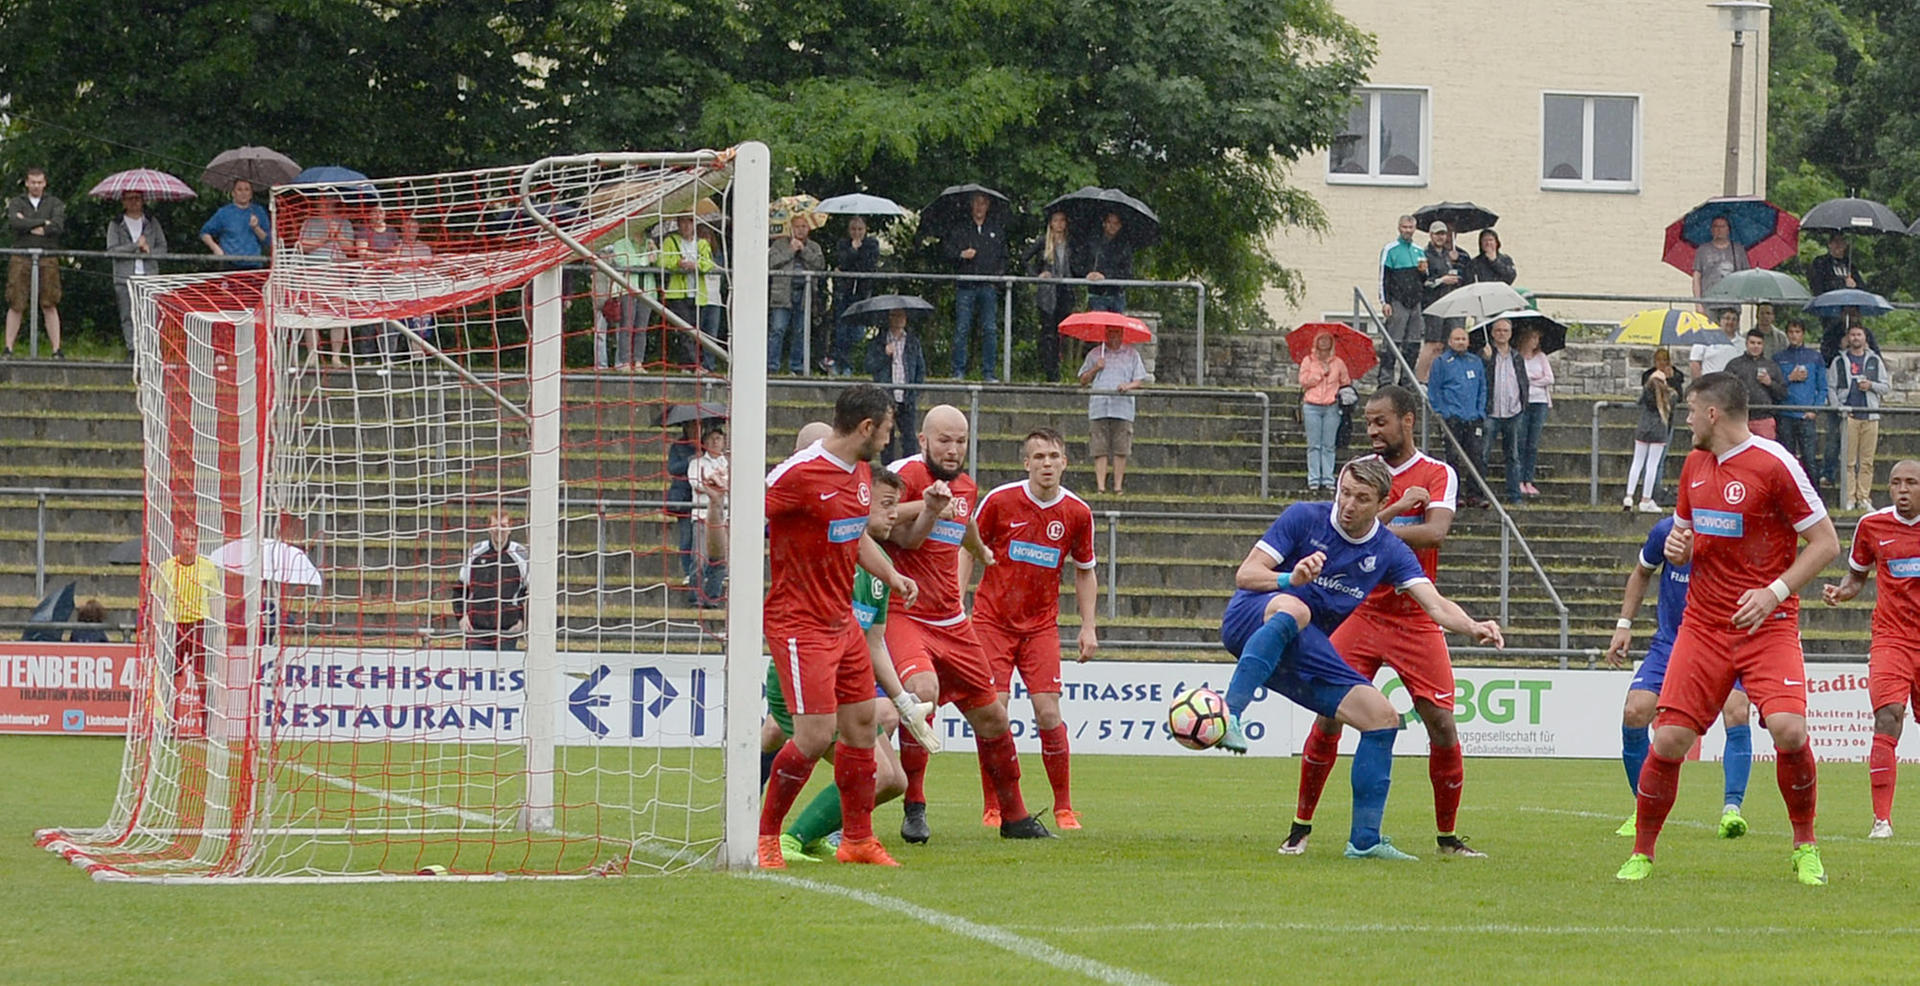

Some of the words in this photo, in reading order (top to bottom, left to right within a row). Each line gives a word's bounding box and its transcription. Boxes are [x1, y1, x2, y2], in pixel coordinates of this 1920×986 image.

[833, 522, 865, 537] HOWOG
[1012, 546, 1055, 563] HOWOGE
[1312, 576, 1365, 600] tWoods
[0, 655, 113, 690] TENBERG
[259, 660, 525, 692] GRIECHISCHES
[1807, 673, 1869, 694] tadio
[568, 664, 706, 740] EPI
[264, 698, 520, 731] RESTAURANT
[1848, 723, 1875, 733] Alex
